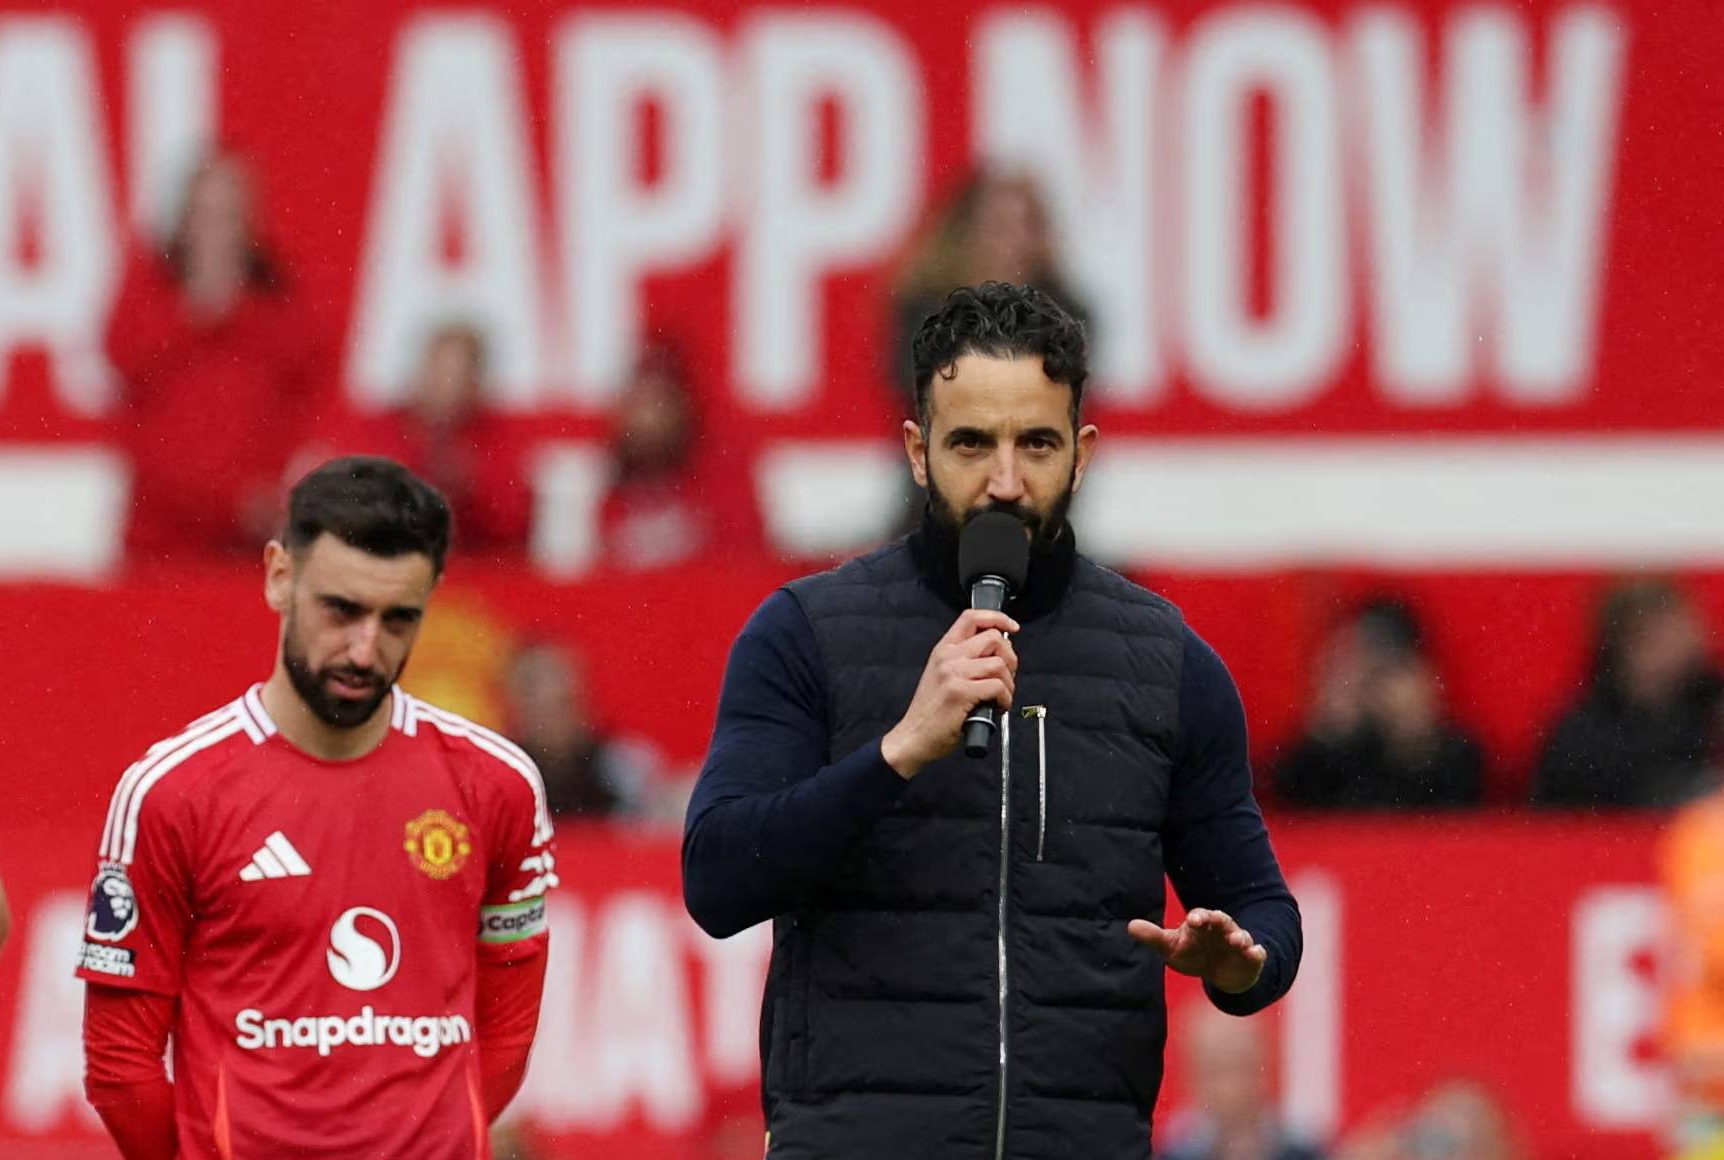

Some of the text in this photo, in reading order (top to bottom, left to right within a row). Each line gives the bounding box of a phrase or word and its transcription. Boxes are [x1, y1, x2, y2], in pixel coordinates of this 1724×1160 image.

[344, 10, 928, 408] APP
[968, 8, 1628, 406] NOW
[235, 1005, 471, 1057] Snapdragon
